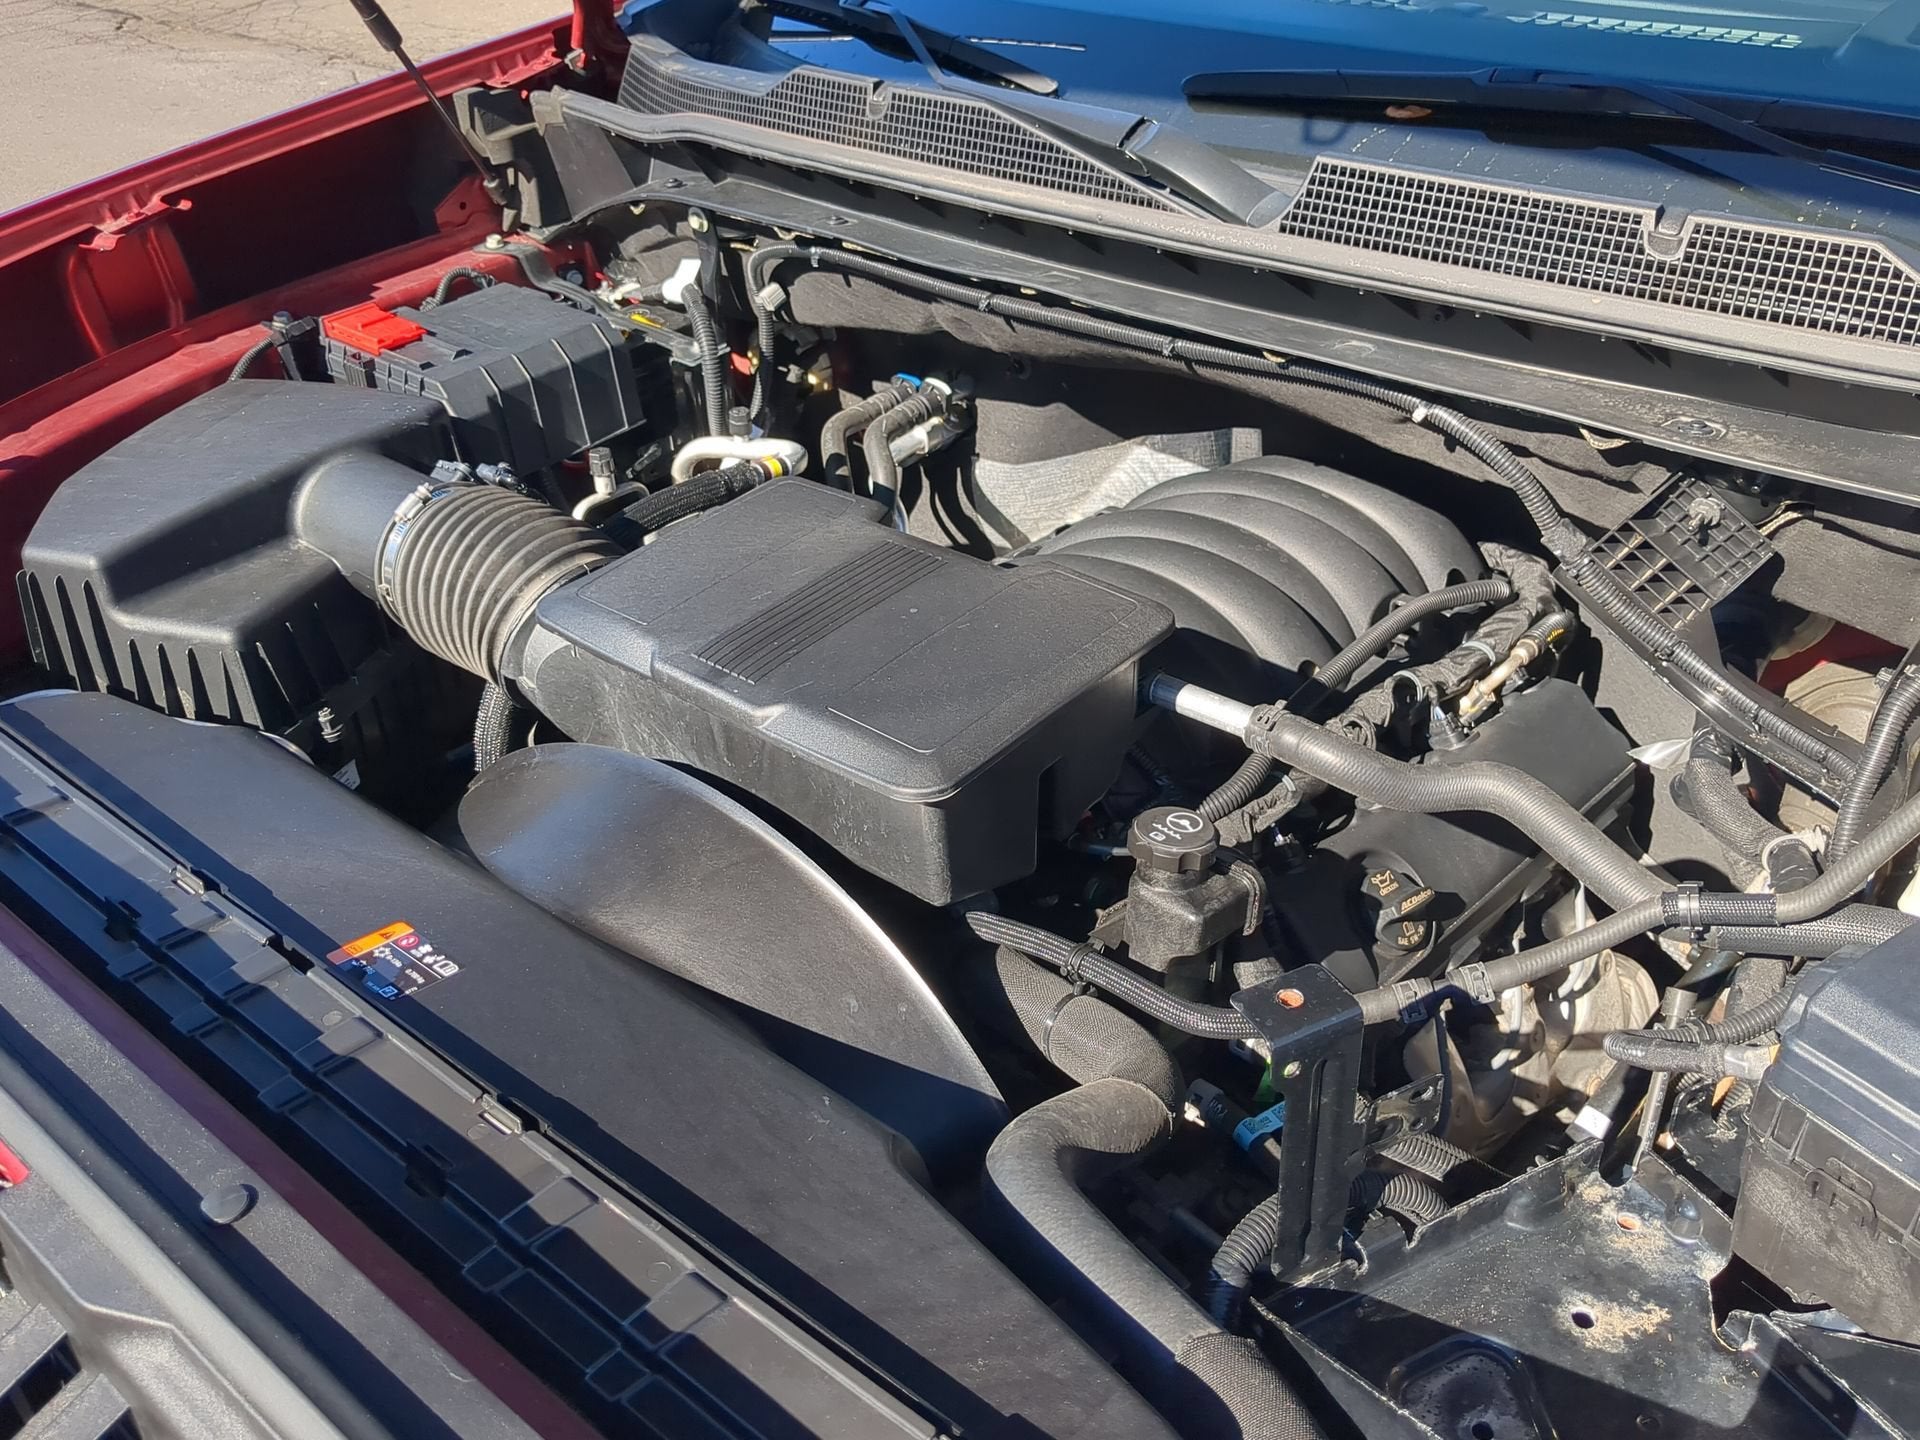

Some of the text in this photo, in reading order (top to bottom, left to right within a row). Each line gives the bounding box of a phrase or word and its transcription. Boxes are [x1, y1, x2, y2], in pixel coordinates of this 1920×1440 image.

[1380, 881, 1399, 896] dexos
[1401, 888, 1432, 911] ACDelco
[1397, 936, 1409, 946] SAE
